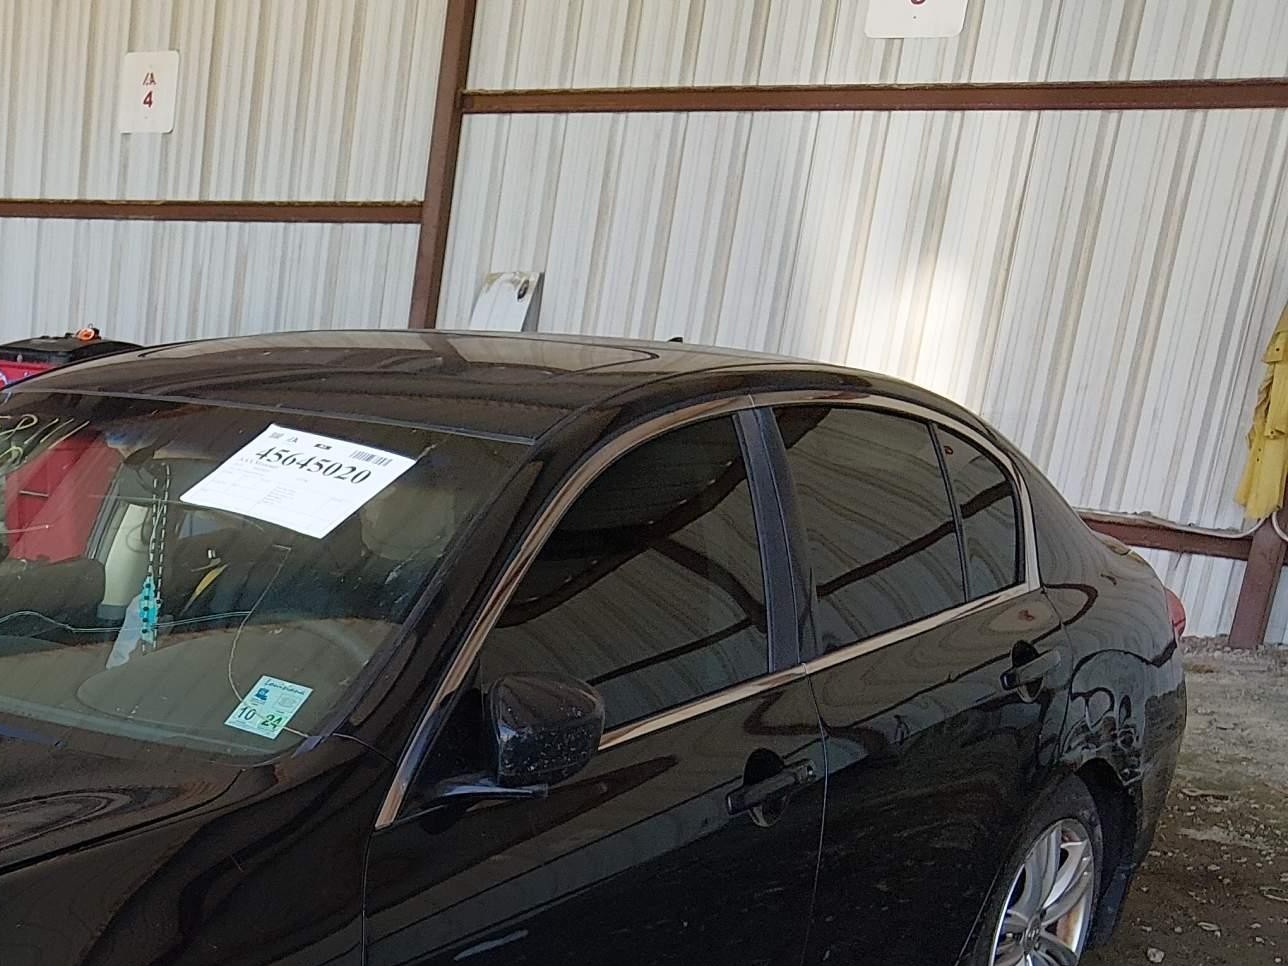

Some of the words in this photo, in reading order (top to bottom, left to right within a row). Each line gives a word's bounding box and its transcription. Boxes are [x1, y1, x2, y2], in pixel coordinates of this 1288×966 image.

[142, 90, 154, 108] 4
[255, 446, 372, 484] 45645020
[237, 705, 257, 721] 10
[260, 714, 283, 730] 24
